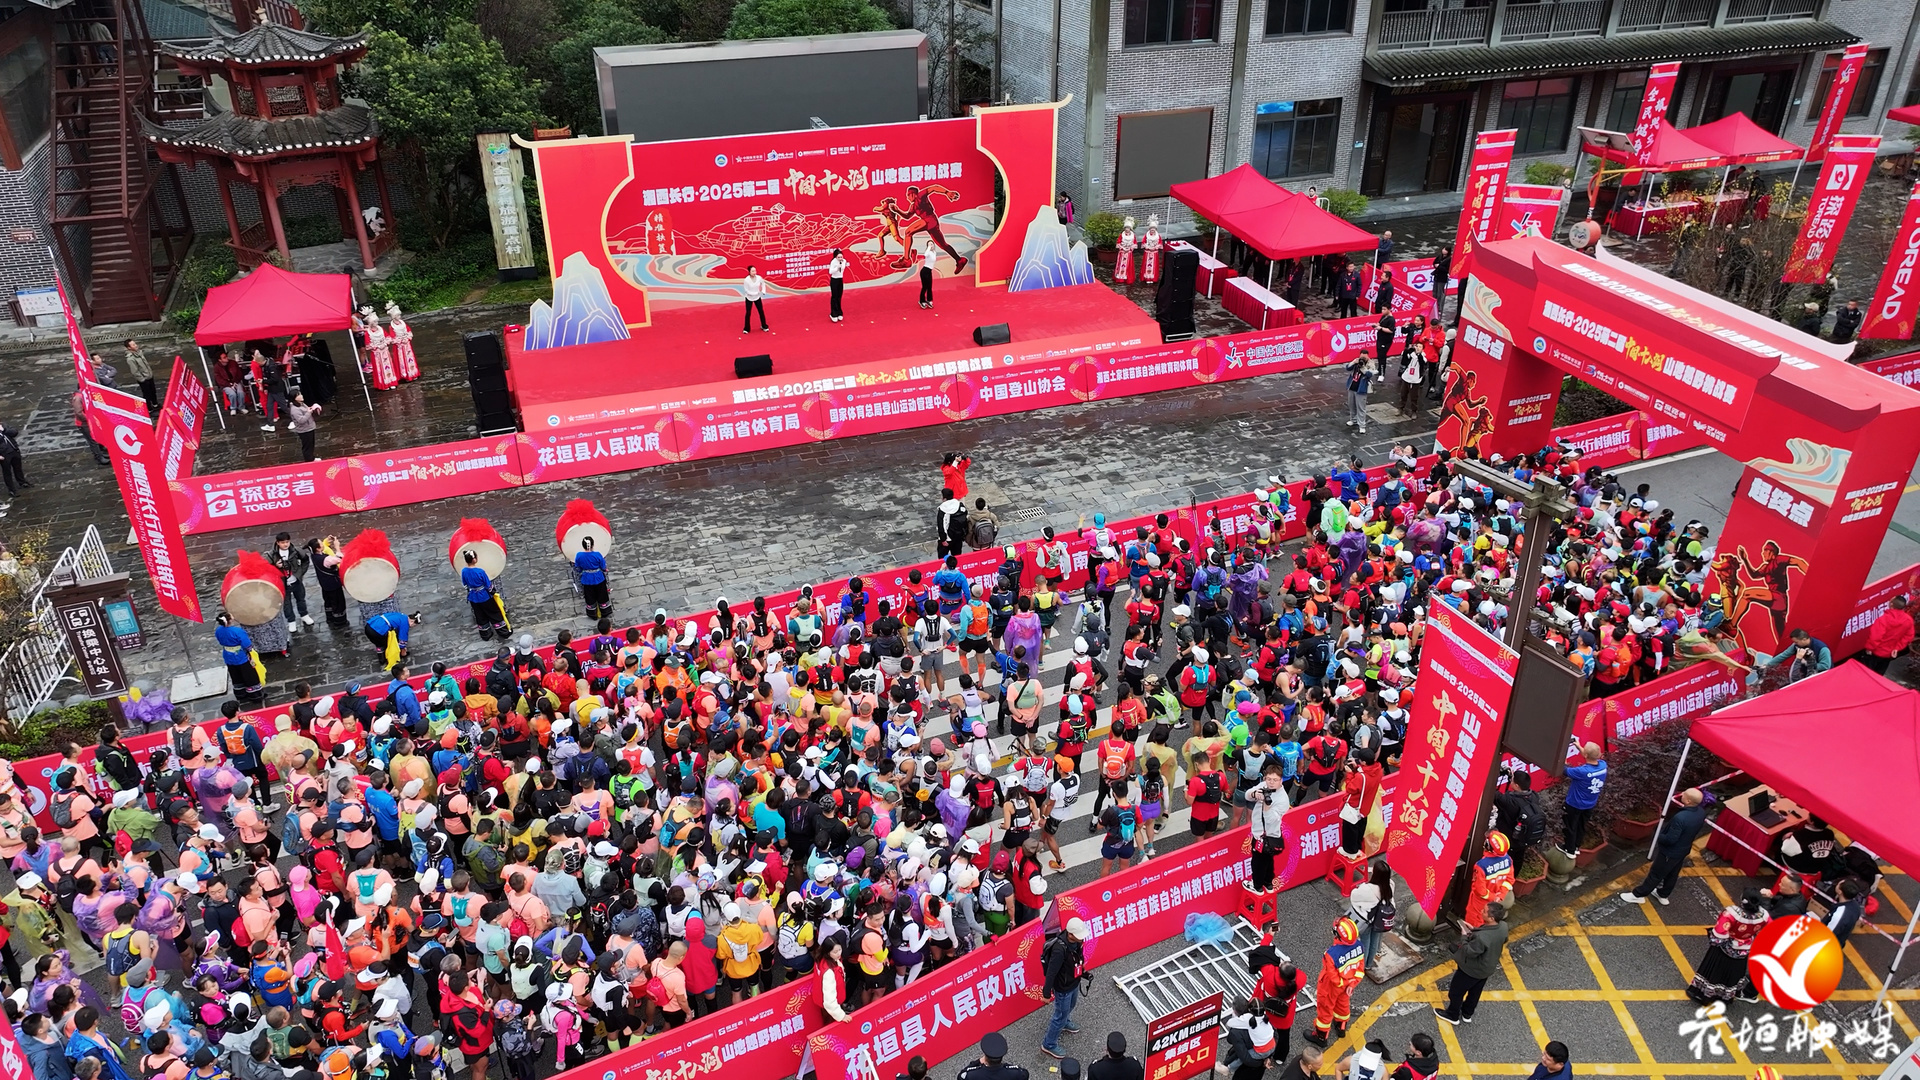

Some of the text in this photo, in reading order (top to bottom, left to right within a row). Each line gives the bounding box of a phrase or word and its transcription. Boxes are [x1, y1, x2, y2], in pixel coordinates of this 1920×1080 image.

[643, 179, 780, 206] 湘西长行·2025第二届
[871, 162, 963, 186] 山地越野挑战赛
[1806, 195, 1845, 260] 探路者
[1807, 197, 1828, 239] TOREAD
[1882, 217, 1920, 320] OREAD
[1246, 340, 1304, 359] 中国体育彩票
[1463, 324, 1505, 361] 起终点
[1542, 299, 1628, 354] 湘西长行·2025第二届
[1662, 357, 1738, 406] 山地越野挑战赛
[732, 375, 856, 404] 湘西长行·2025第二届
[908, 356, 993, 380] 山地越野挑战赛
[979, 375, 1066, 402] 中国登山协会
[701, 412, 800, 443] 湖南省体育局
[829, 394, 951, 423] 国家体育总局登山运动管理中心
[363, 468, 409, 486] 2025第二届
[456, 454, 508, 473] 山地越野挑战赛
[538, 432, 660, 466] 花垣县人民政府
[239, 479, 316, 504] 探路者
[242, 499, 292, 513] TOREAD
[1748, 477, 1814, 528] 起终点
[129, 459, 179, 601] 湘西长行村镇银行
[82, 629, 110, 675] 换乘中心处
[1430, 658, 1498, 722] 湘西长行·2025第二届
[1615, 678, 1739, 739] 国家体育总局登山运动管理中心
[1399, 689, 1458, 836] 中国·十八洞
[1427, 709, 1481, 860] 山地越野挑战赛
[721, 1013, 805, 1063] 山地越野挑战赛
[844, 960, 1026, 1080] 花垣县人民政府
[1152, 1027, 1189, 1051] 42KM
[1153, 1046, 1210, 1080] 通道入口
